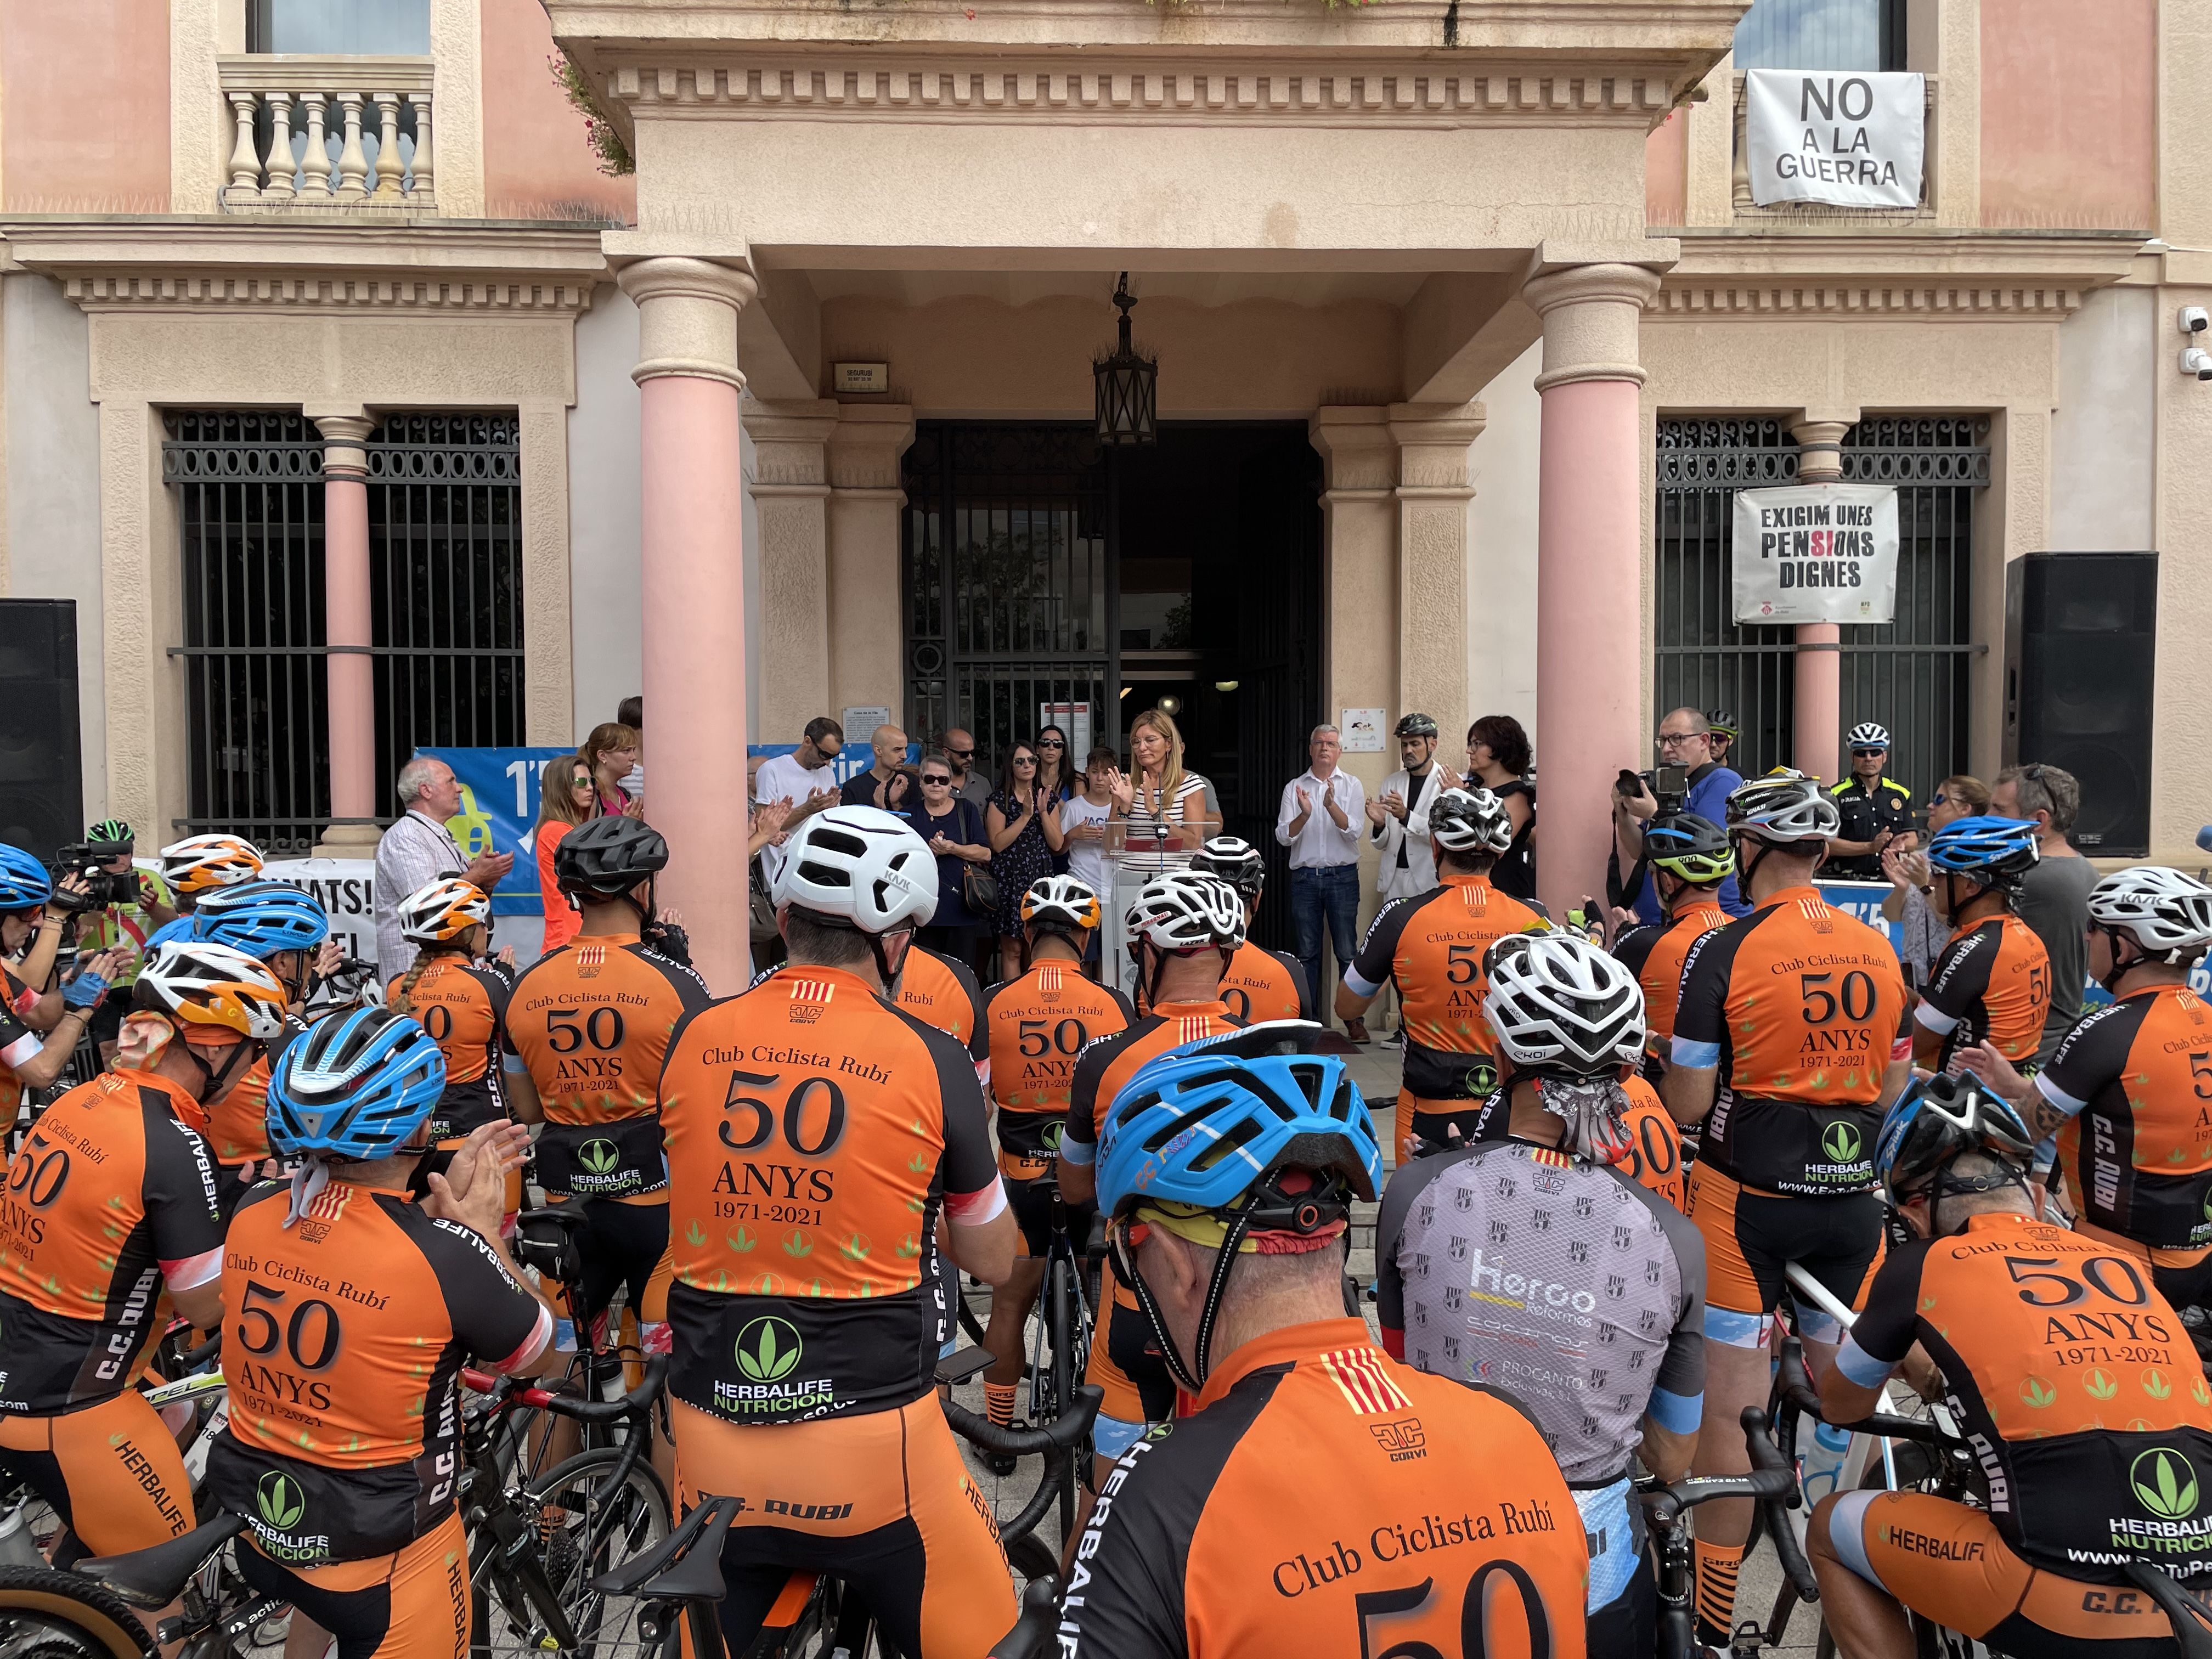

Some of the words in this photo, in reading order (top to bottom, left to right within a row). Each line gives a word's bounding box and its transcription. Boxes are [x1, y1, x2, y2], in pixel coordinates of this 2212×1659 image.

[1800, 77, 1874, 122] NO
[1802, 127, 1820, 154] A
[1832, 127, 1871, 154] LA
[1775, 153, 1900, 187] GUERRA
[1760, 504, 1830, 528] EXIGIM
[1836, 504, 1873, 526] UNES
[1761, 530, 1875, 559] PENSIONS
[1779, 561, 1861, 589] DIGNES
[1746, 803, 1766, 816] IGNASI
[884, 870, 911, 891] KASK
[2120, 894, 2164, 905] KASK
[1361, 898, 1401, 957] HERBALIFE
[1426, 932, 1454, 943] Club
[1457, 930, 1500, 940] Ciclista
[1771, 957, 1804, 975] Club
[1807, 953, 1858, 968] Ciclista
[1860, 953, 1888, 969] Rubí
[1934, 935, 1983, 994] HERBALIFE
[1244, 974, 1272, 990] Rubí
[445, 992, 472, 1004] Rubí
[525, 995, 554, 1012] Club
[558, 992, 611, 1005] Ciclista
[615, 992, 650, 1007] Rubí
[904, 991, 934, 1007] Rubí
[1800, 970, 1877, 1025] 50
[424, 1004, 452, 1041] 0
[998, 1007, 1025, 1020] Club
[1028, 1006, 1073, 1016] Ciclista
[1077, 1005, 1104, 1017] Rubí
[1448, 1009, 1484, 1019] 1971-2
[546, 1007, 624, 1053] 50
[1018, 1018, 1087, 1057] 50
[1799, 1029, 1872, 1053] ANYS
[2055, 1005, 2128, 1066] HERBALIFE
[1799, 1054, 1865, 1068] 1971-2021
[2163, 1039, 2190, 1055] Club
[555, 1057, 624, 1080] ANYS
[702, 1047, 744, 1065] Club
[751, 1045, 831, 1068] Ciclista
[838, 1054, 893, 1086] Rubí
[558, 1079, 619, 1094] 1971-2021
[1023, 1079, 1073, 1090] 1971-202
[718, 1069, 846, 1156] 50
[48, 1118, 78, 1146] Ciclista
[76, 1137, 110, 1165] Rubí
[2092, 1113, 2116, 1156] C.C.
[10, 1132, 71, 1207] 50
[168, 1118, 218, 1211] HERBALIFE
[569, 1169, 641, 1184] HERBALIFE
[1804, 1160, 1872, 1174] HERBALIFE
[712, 1161, 834, 1203] ANYS
[2094, 1155, 2121, 1212] RUBI
[713, 1200, 823, 1226] 1971-2021
[432, 1218, 515, 1290] HERBALIFE
[1950, 1242, 2008, 1260] Club
[2014, 1241, 2101, 1253] Ciclista
[226, 1252, 258, 1272] Club
[264, 1260, 330, 1292] Ciclista
[336, 1280, 391, 1312] Rubí
[2004, 1255, 2147, 1307] 50
[95, 1330, 136, 1380] C.C.
[117, 1268, 159, 1327] RUBI
[238, 1279, 340, 1370] 50
[1525, 1301, 1593, 1328] Reformes
[2043, 1313, 2172, 1346] ANYS
[2052, 1345, 2175, 1367] 1971-2021
[240, 1360, 332, 1410] ANYS
[714, 1378, 833, 1400] HERBALIFE
[1502, 1360, 1583, 1390] PROCANTO
[241, 1392, 323, 1428] 1971-2021
[714, 1390, 834, 1414] NUTRICIÓN
[1389, 1448, 1427, 1463] CORVI
[429, 1442, 455, 1505] C.C.
[1966, 1432, 2011, 1513] RUBI
[114, 1440, 188, 1537] HERBALIFE
[764, 1499, 854, 1520] RUBI
[1272, 1542, 1363, 1600] Club
[1369, 1509, 1497, 1564] Ciclista
[1500, 1498, 1557, 1534] Rubí
[1354, 1558, 1551, 1659] 50
[2081, 1591, 2143, 1615] C.C.
